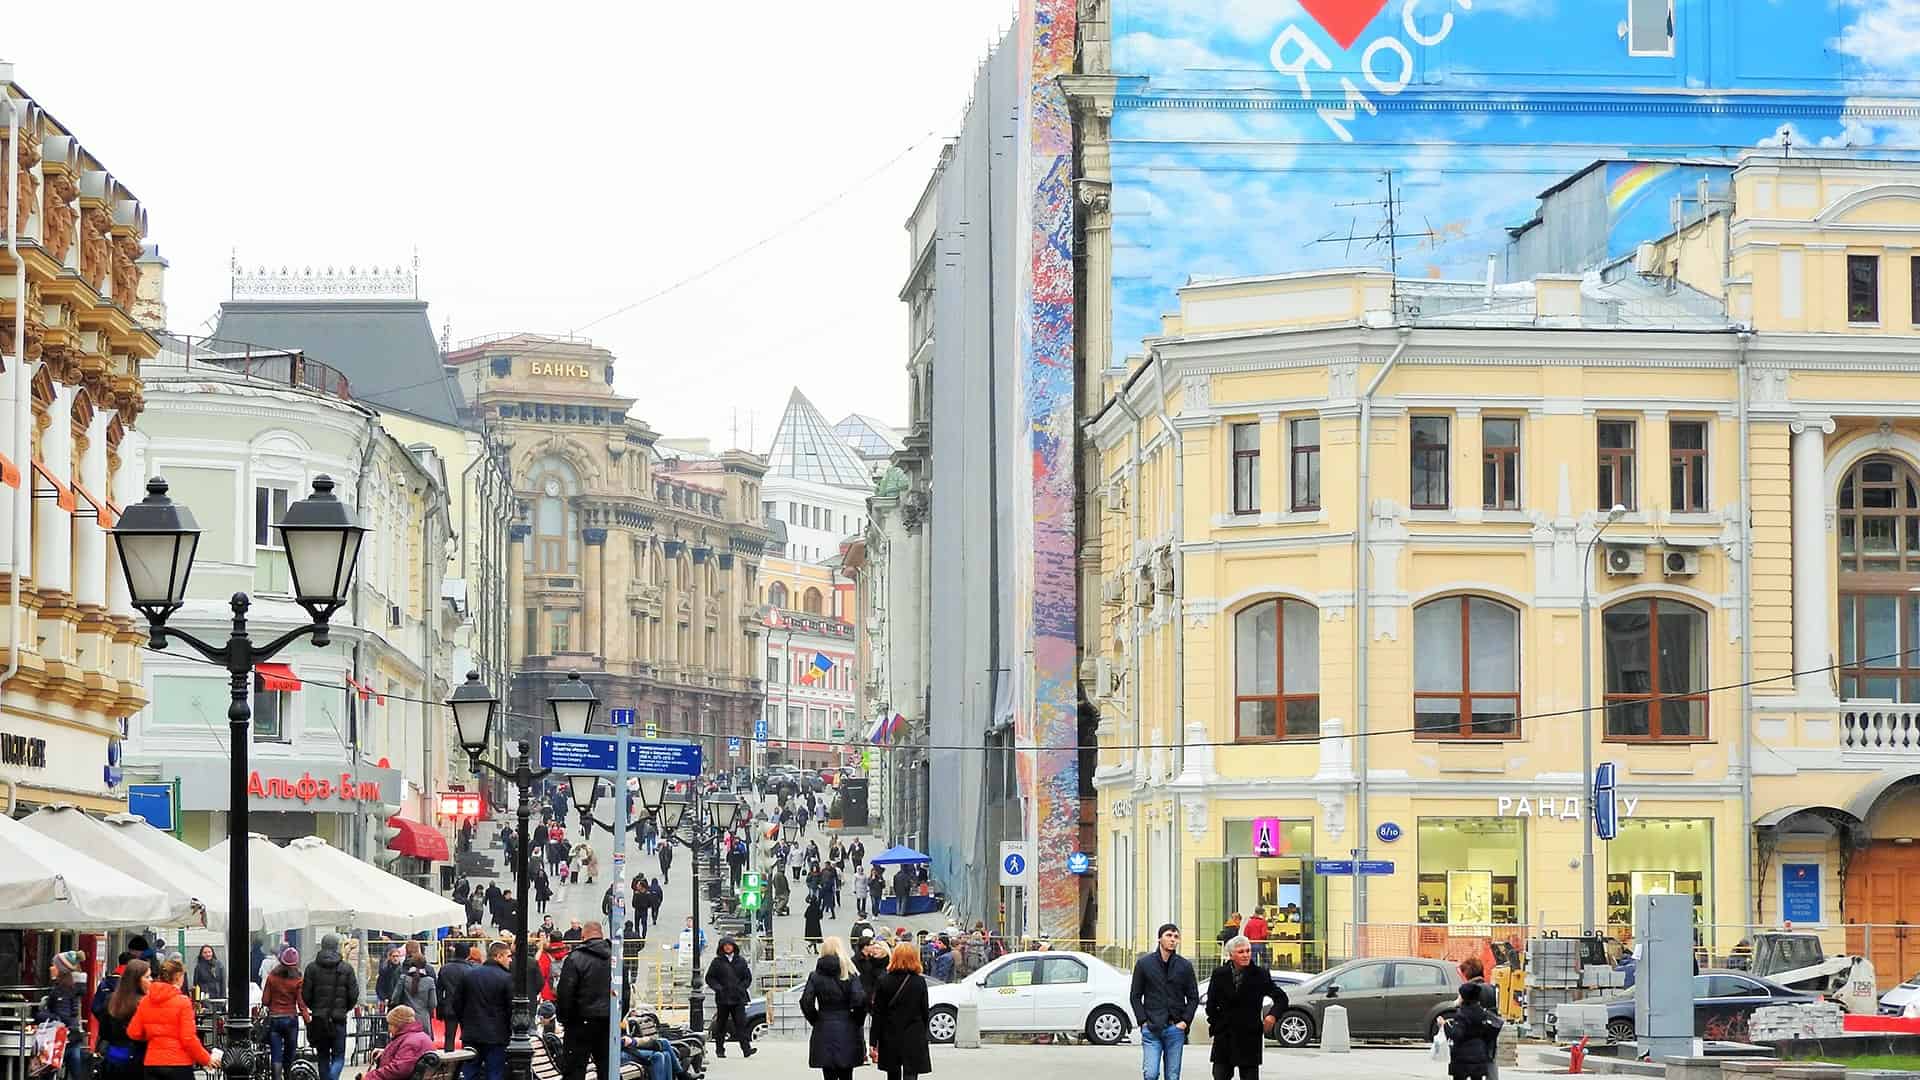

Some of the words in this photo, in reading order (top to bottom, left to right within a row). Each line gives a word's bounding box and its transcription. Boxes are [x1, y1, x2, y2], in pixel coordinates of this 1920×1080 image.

[1269, 24, 1332, 100] Я
[1317, 0, 1472, 141] МОС
[532, 362, 589, 377] БАНКЪ
[1498, 796, 1639, 821] РАНДУ
[1381, 827, 1398, 836] 8/10
